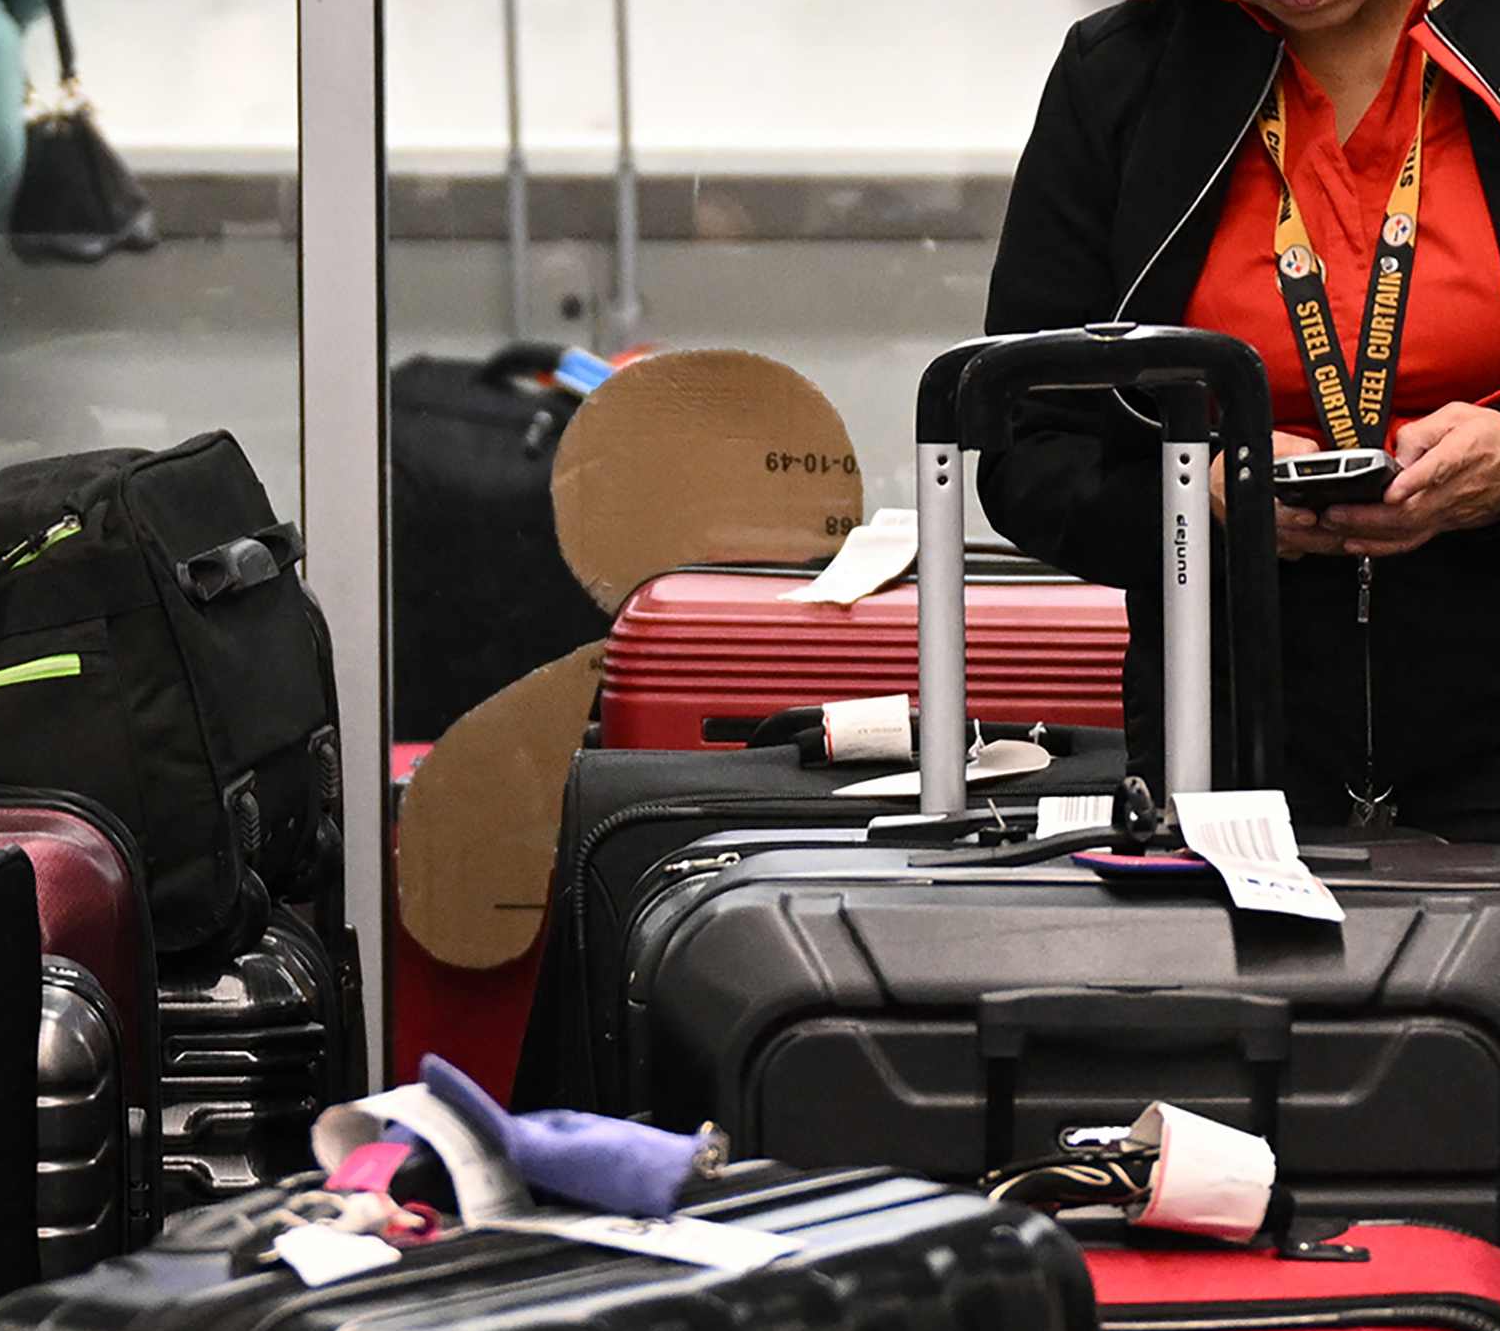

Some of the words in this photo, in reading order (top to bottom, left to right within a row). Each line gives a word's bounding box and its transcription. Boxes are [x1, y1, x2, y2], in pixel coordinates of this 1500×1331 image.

[1296, 300, 1332, 361] STEEL
[1358, 368, 1388, 426] STEEL
[766, 451, 859, 476] 0-10-49
